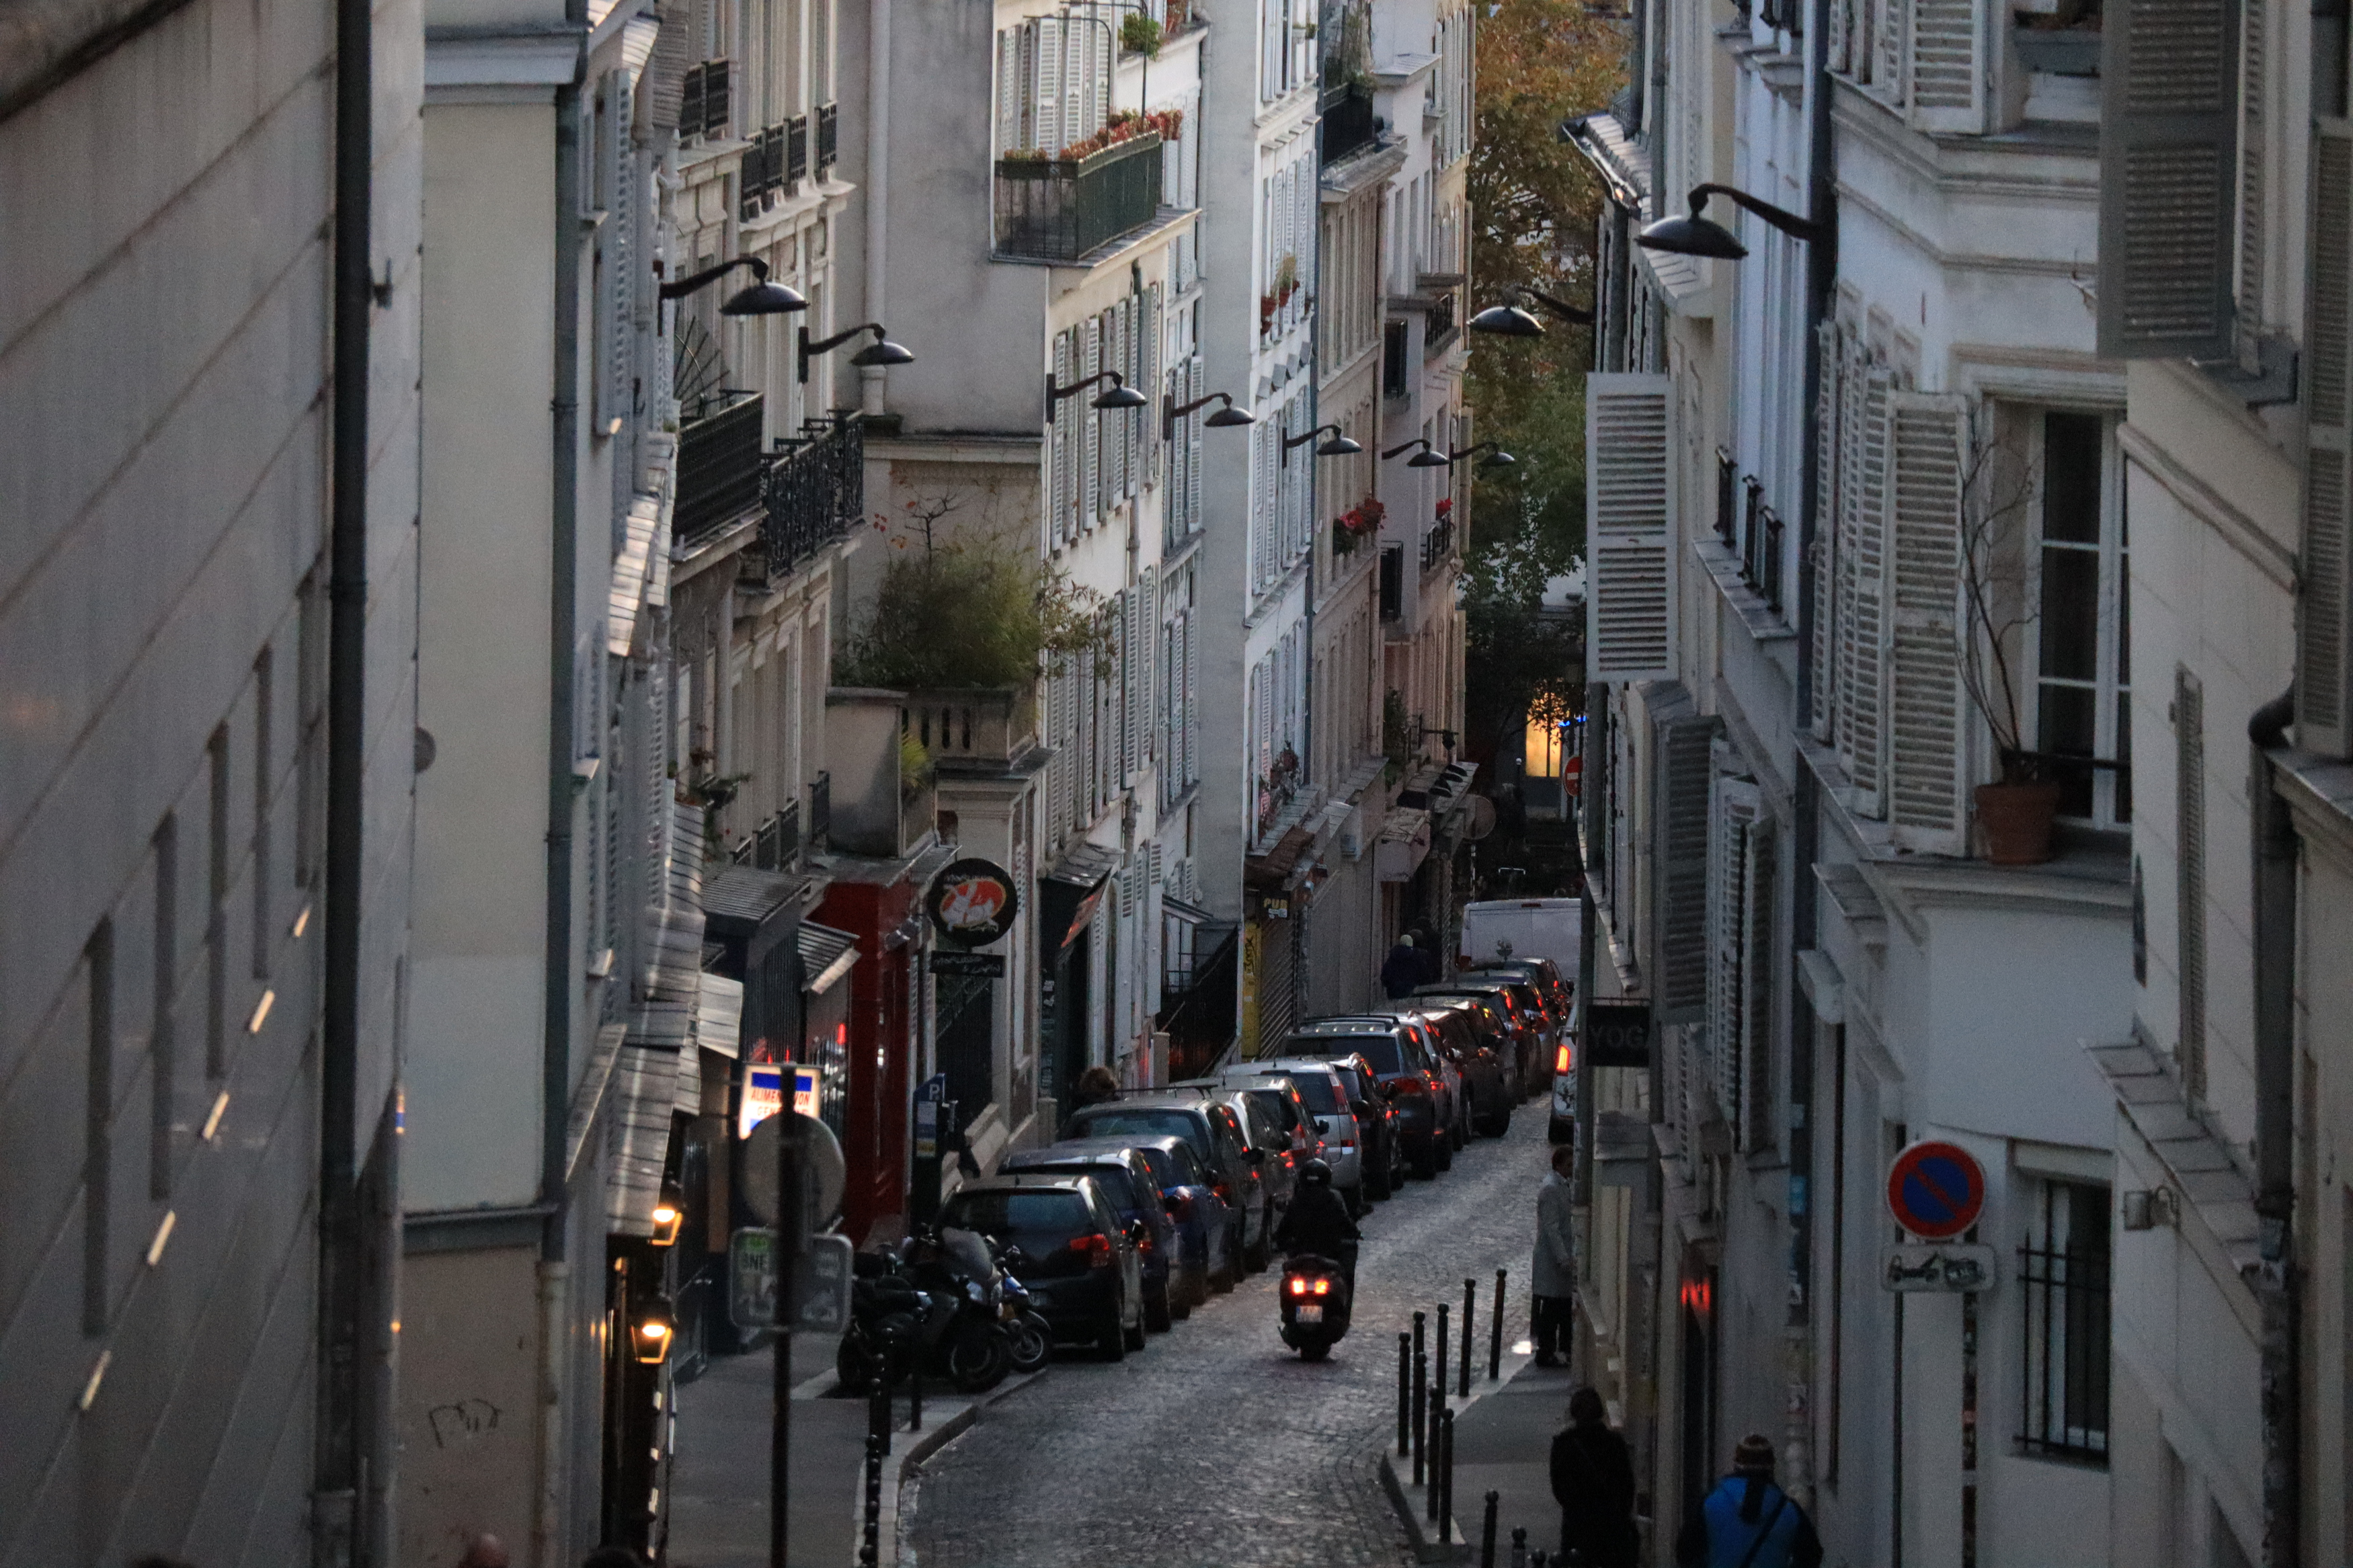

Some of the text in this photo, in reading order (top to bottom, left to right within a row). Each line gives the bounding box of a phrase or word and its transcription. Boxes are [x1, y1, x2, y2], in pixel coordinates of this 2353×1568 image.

[1263, 897, 1288, 909] PUB
[1588, 1024, 1650, 1050] YOG
[751, 1088, 811, 1106] ALIMENION
